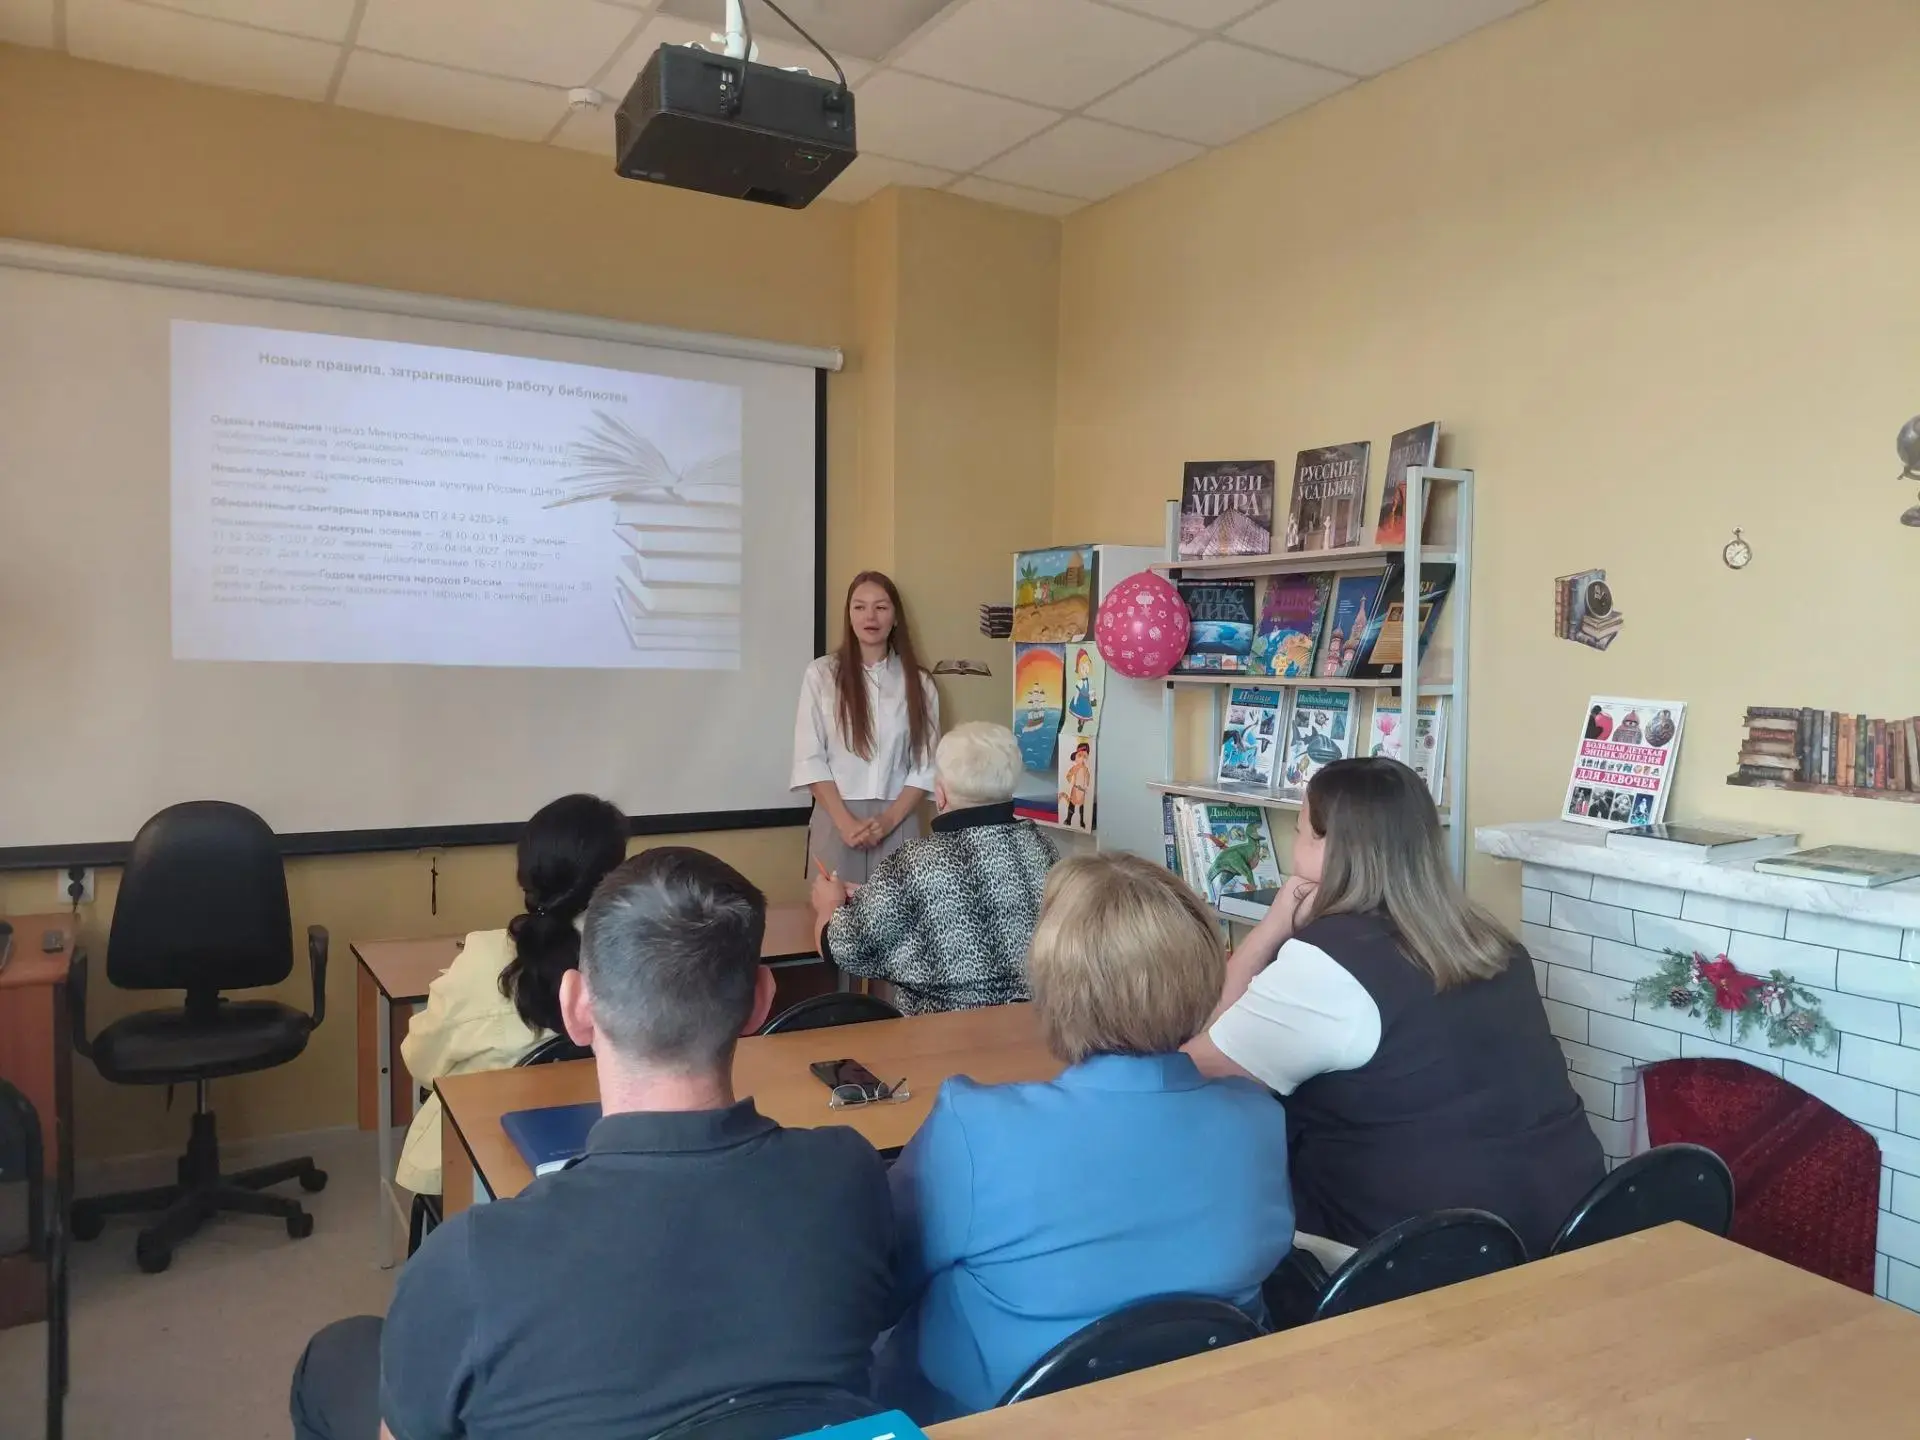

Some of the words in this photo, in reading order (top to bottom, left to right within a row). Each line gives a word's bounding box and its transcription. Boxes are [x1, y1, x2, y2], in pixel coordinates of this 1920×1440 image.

[258, 351, 312, 368] Новые
[388, 365, 503, 388] затрагивающие
[507, 378, 554, 396] работу
[558, 384, 628, 404] библиотек
[1299, 459, 1357, 483] РУССКИЕ
[1191, 474, 1262, 492] МУЗЕИ
[1298, 477, 1356, 501] УСАДЬБЫ
[1191, 492, 1261, 517] МИРА
[414, 574, 461, 586] народов
[463, 577, 503, 587] России
[1188, 588, 1245, 603] АТЛАС
[1186, 603, 1250, 621] МИРА
[1583, 747, 1662, 765] ЭНЦИКЛОПЕДИЯ
[1585, 741, 1625, 753] БОЛЬШАЯ
[1625, 746, 1664, 757] ДЕТСКАЯ
[1577, 768, 1601, 781] ДЛЯ
[1601, 771, 1657, 789] ДЕВОЧЕК
